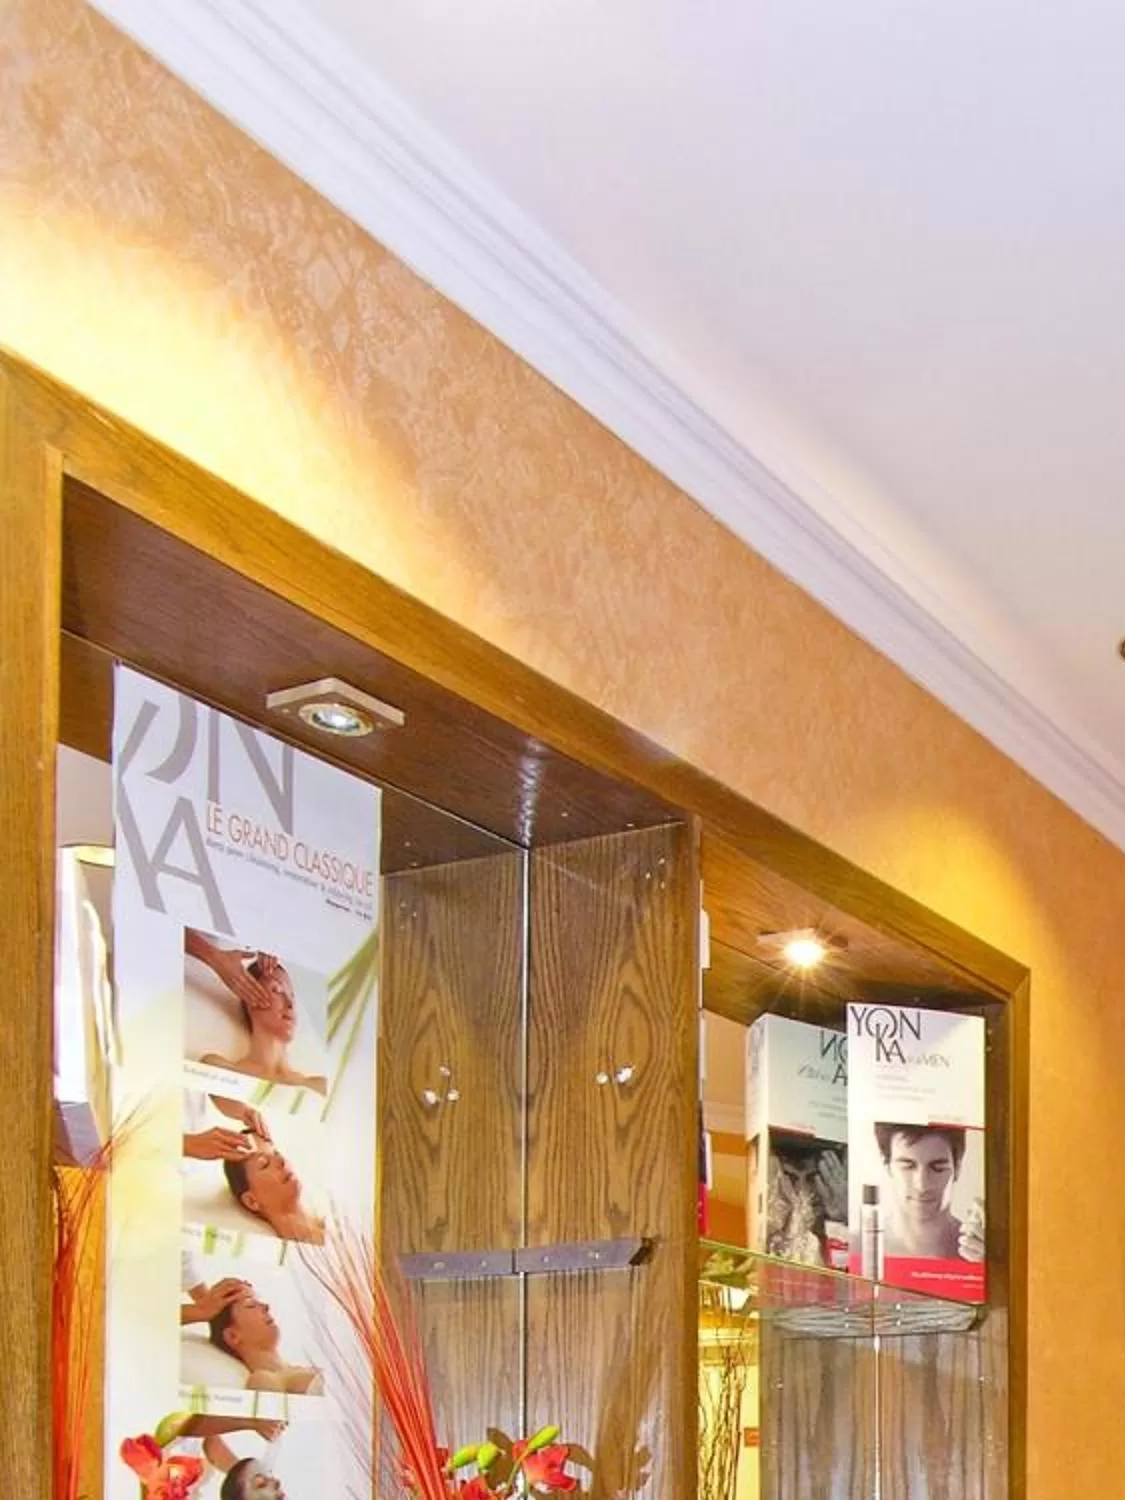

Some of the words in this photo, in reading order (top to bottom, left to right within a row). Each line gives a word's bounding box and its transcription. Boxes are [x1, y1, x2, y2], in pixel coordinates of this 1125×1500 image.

[207, 802, 223, 835] LE
[228, 815, 289, 861] GRAND
[293, 842, 373, 897] CLASSIQUE
[850, 1006, 921, 1040] YON
[876, 1023, 906, 1065] KA
